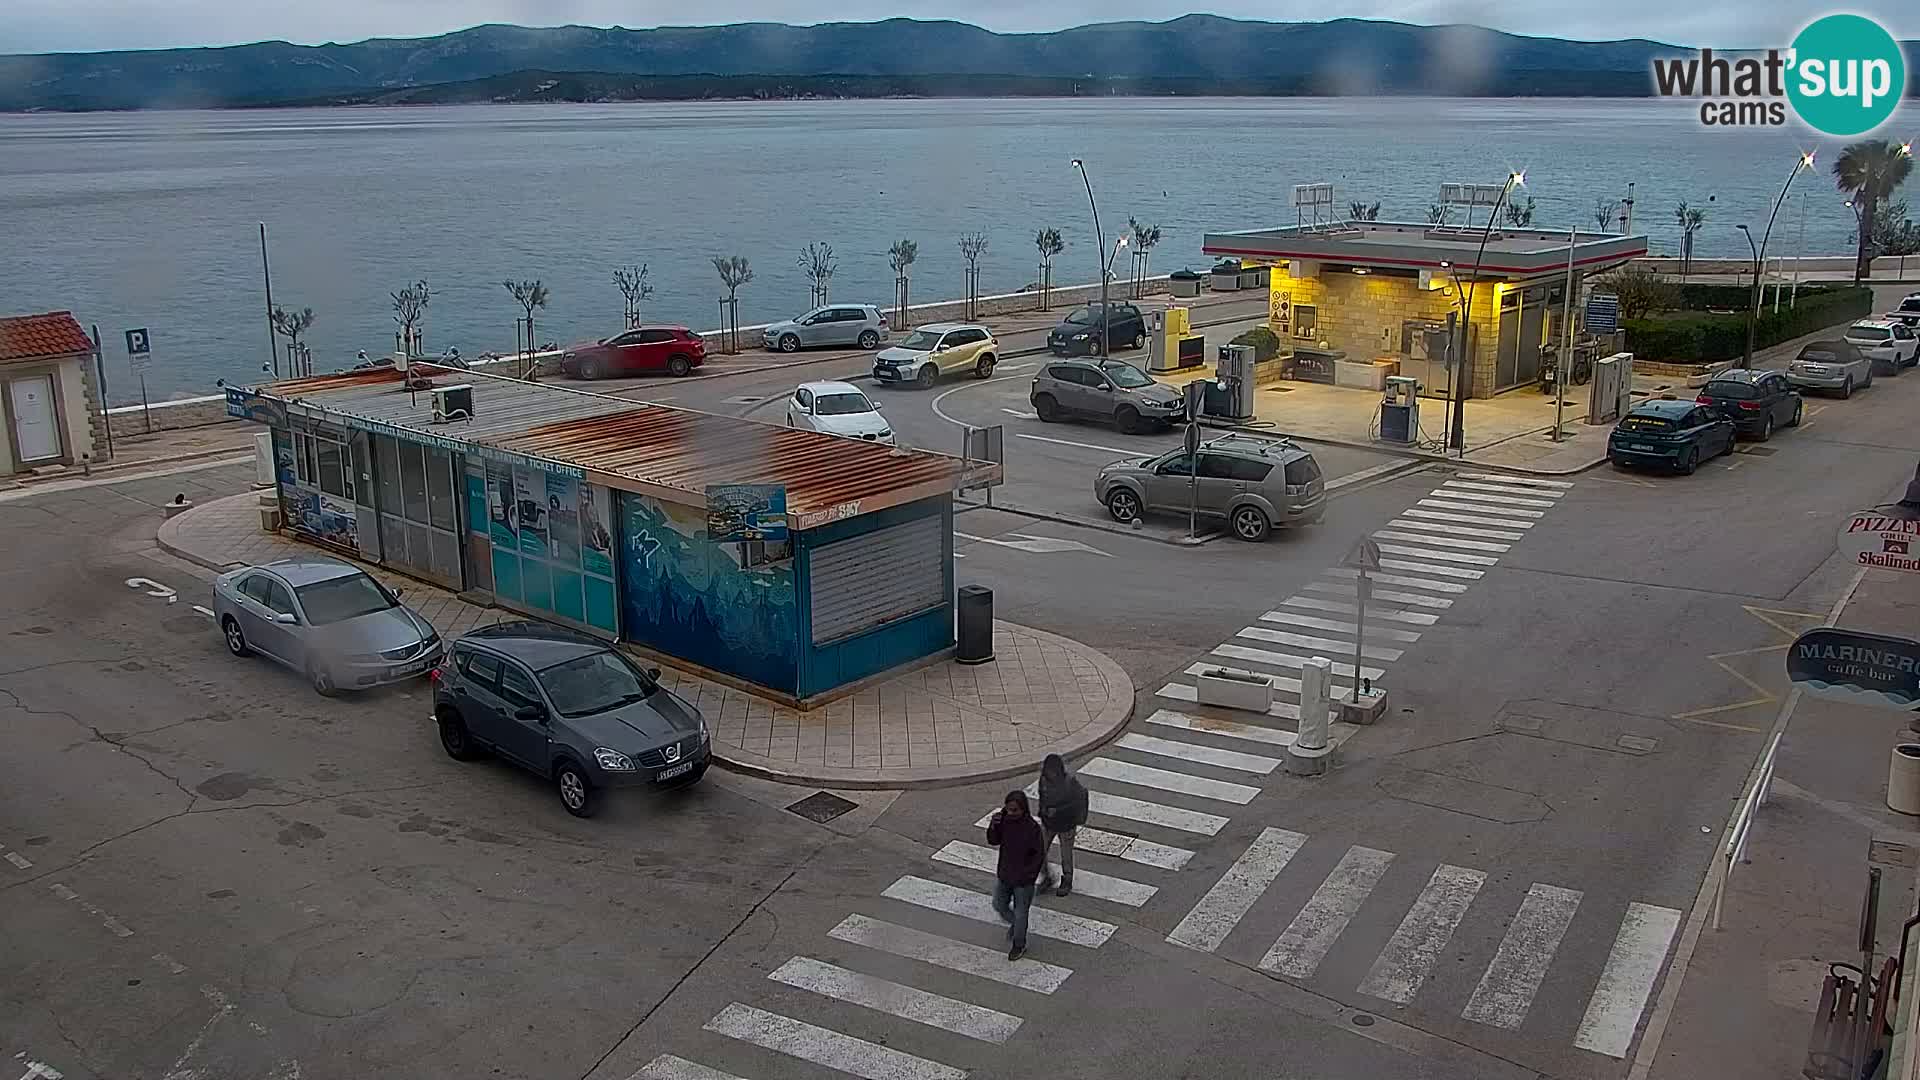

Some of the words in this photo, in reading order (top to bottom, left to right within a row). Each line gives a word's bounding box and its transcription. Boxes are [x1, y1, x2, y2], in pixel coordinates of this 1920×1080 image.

[437, 438, 468, 453] POSTAJA
[478, 447, 493, 458] BUS
[496, 450, 526, 465] STATION
[529, 458, 554, 472] TICKET
[556, 464, 582, 478] OFFICE
[1827, 664, 1864, 676] caffe
[1869, 666, 1896, 681] bar
